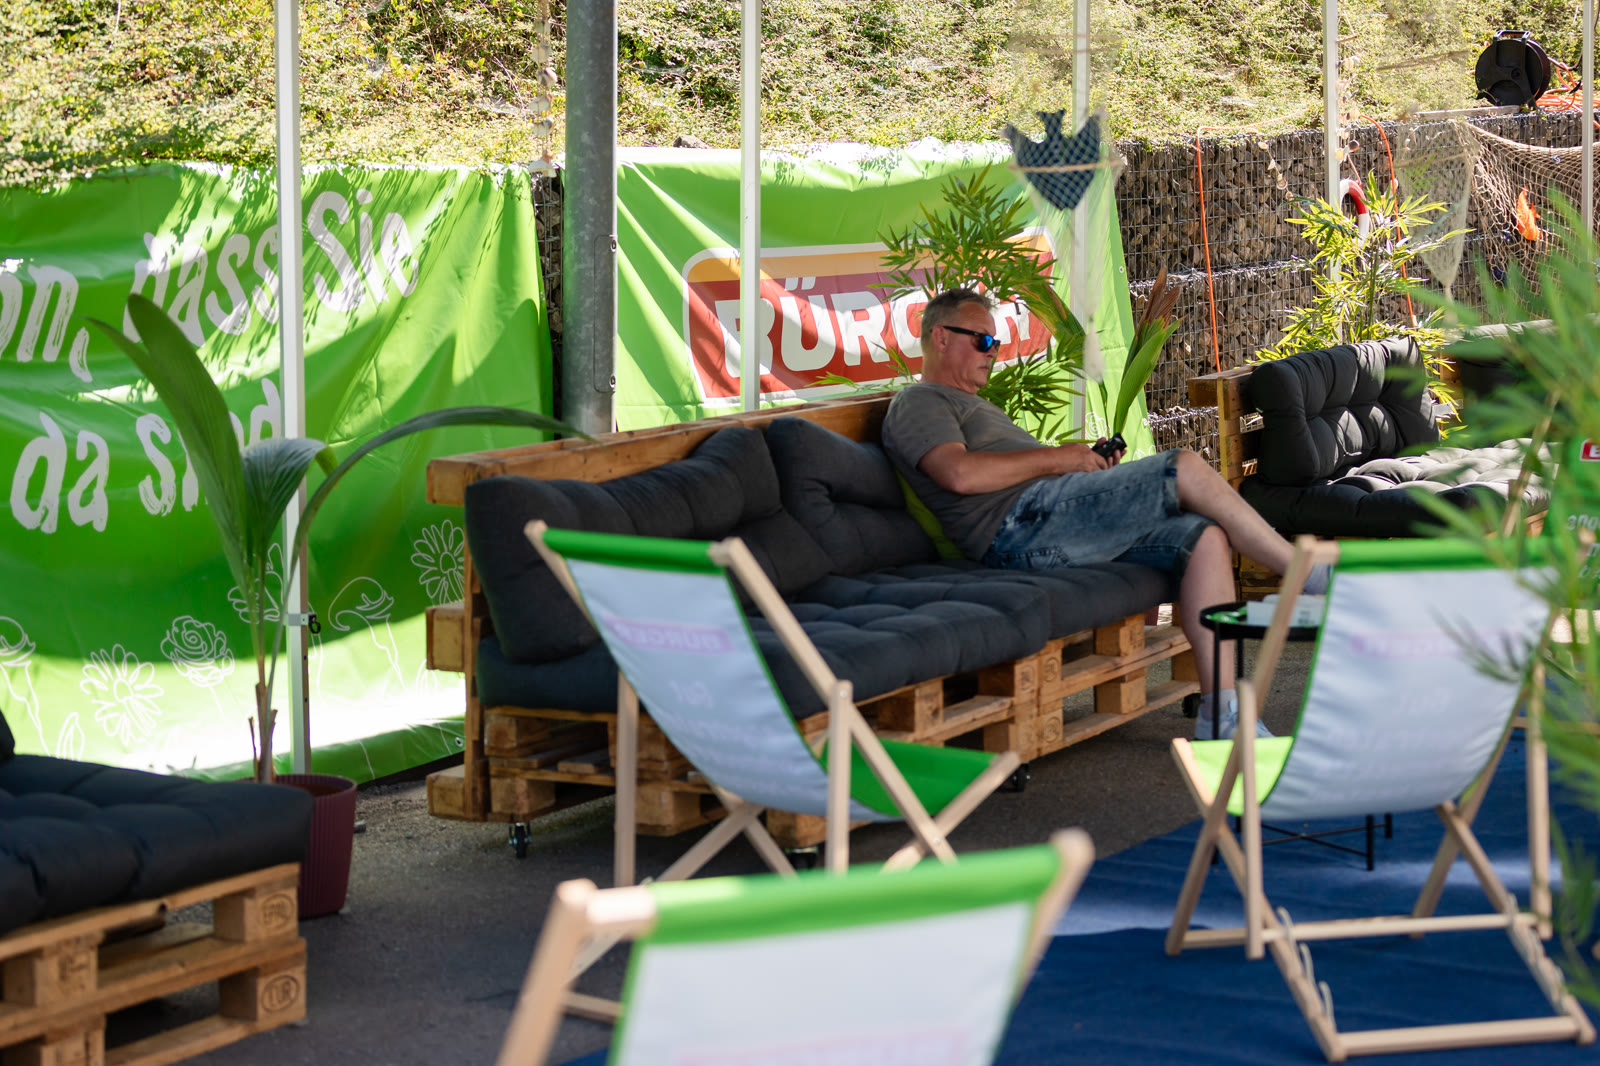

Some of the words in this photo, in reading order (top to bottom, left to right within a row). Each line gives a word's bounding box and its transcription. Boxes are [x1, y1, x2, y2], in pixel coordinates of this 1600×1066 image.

[122, 224, 281, 347] dass
[307, 188, 419, 312] Sie
[714, 276, 1031, 378] BÜRGR
[10, 410, 110, 534] da
[136, 377, 281, 517] sid
